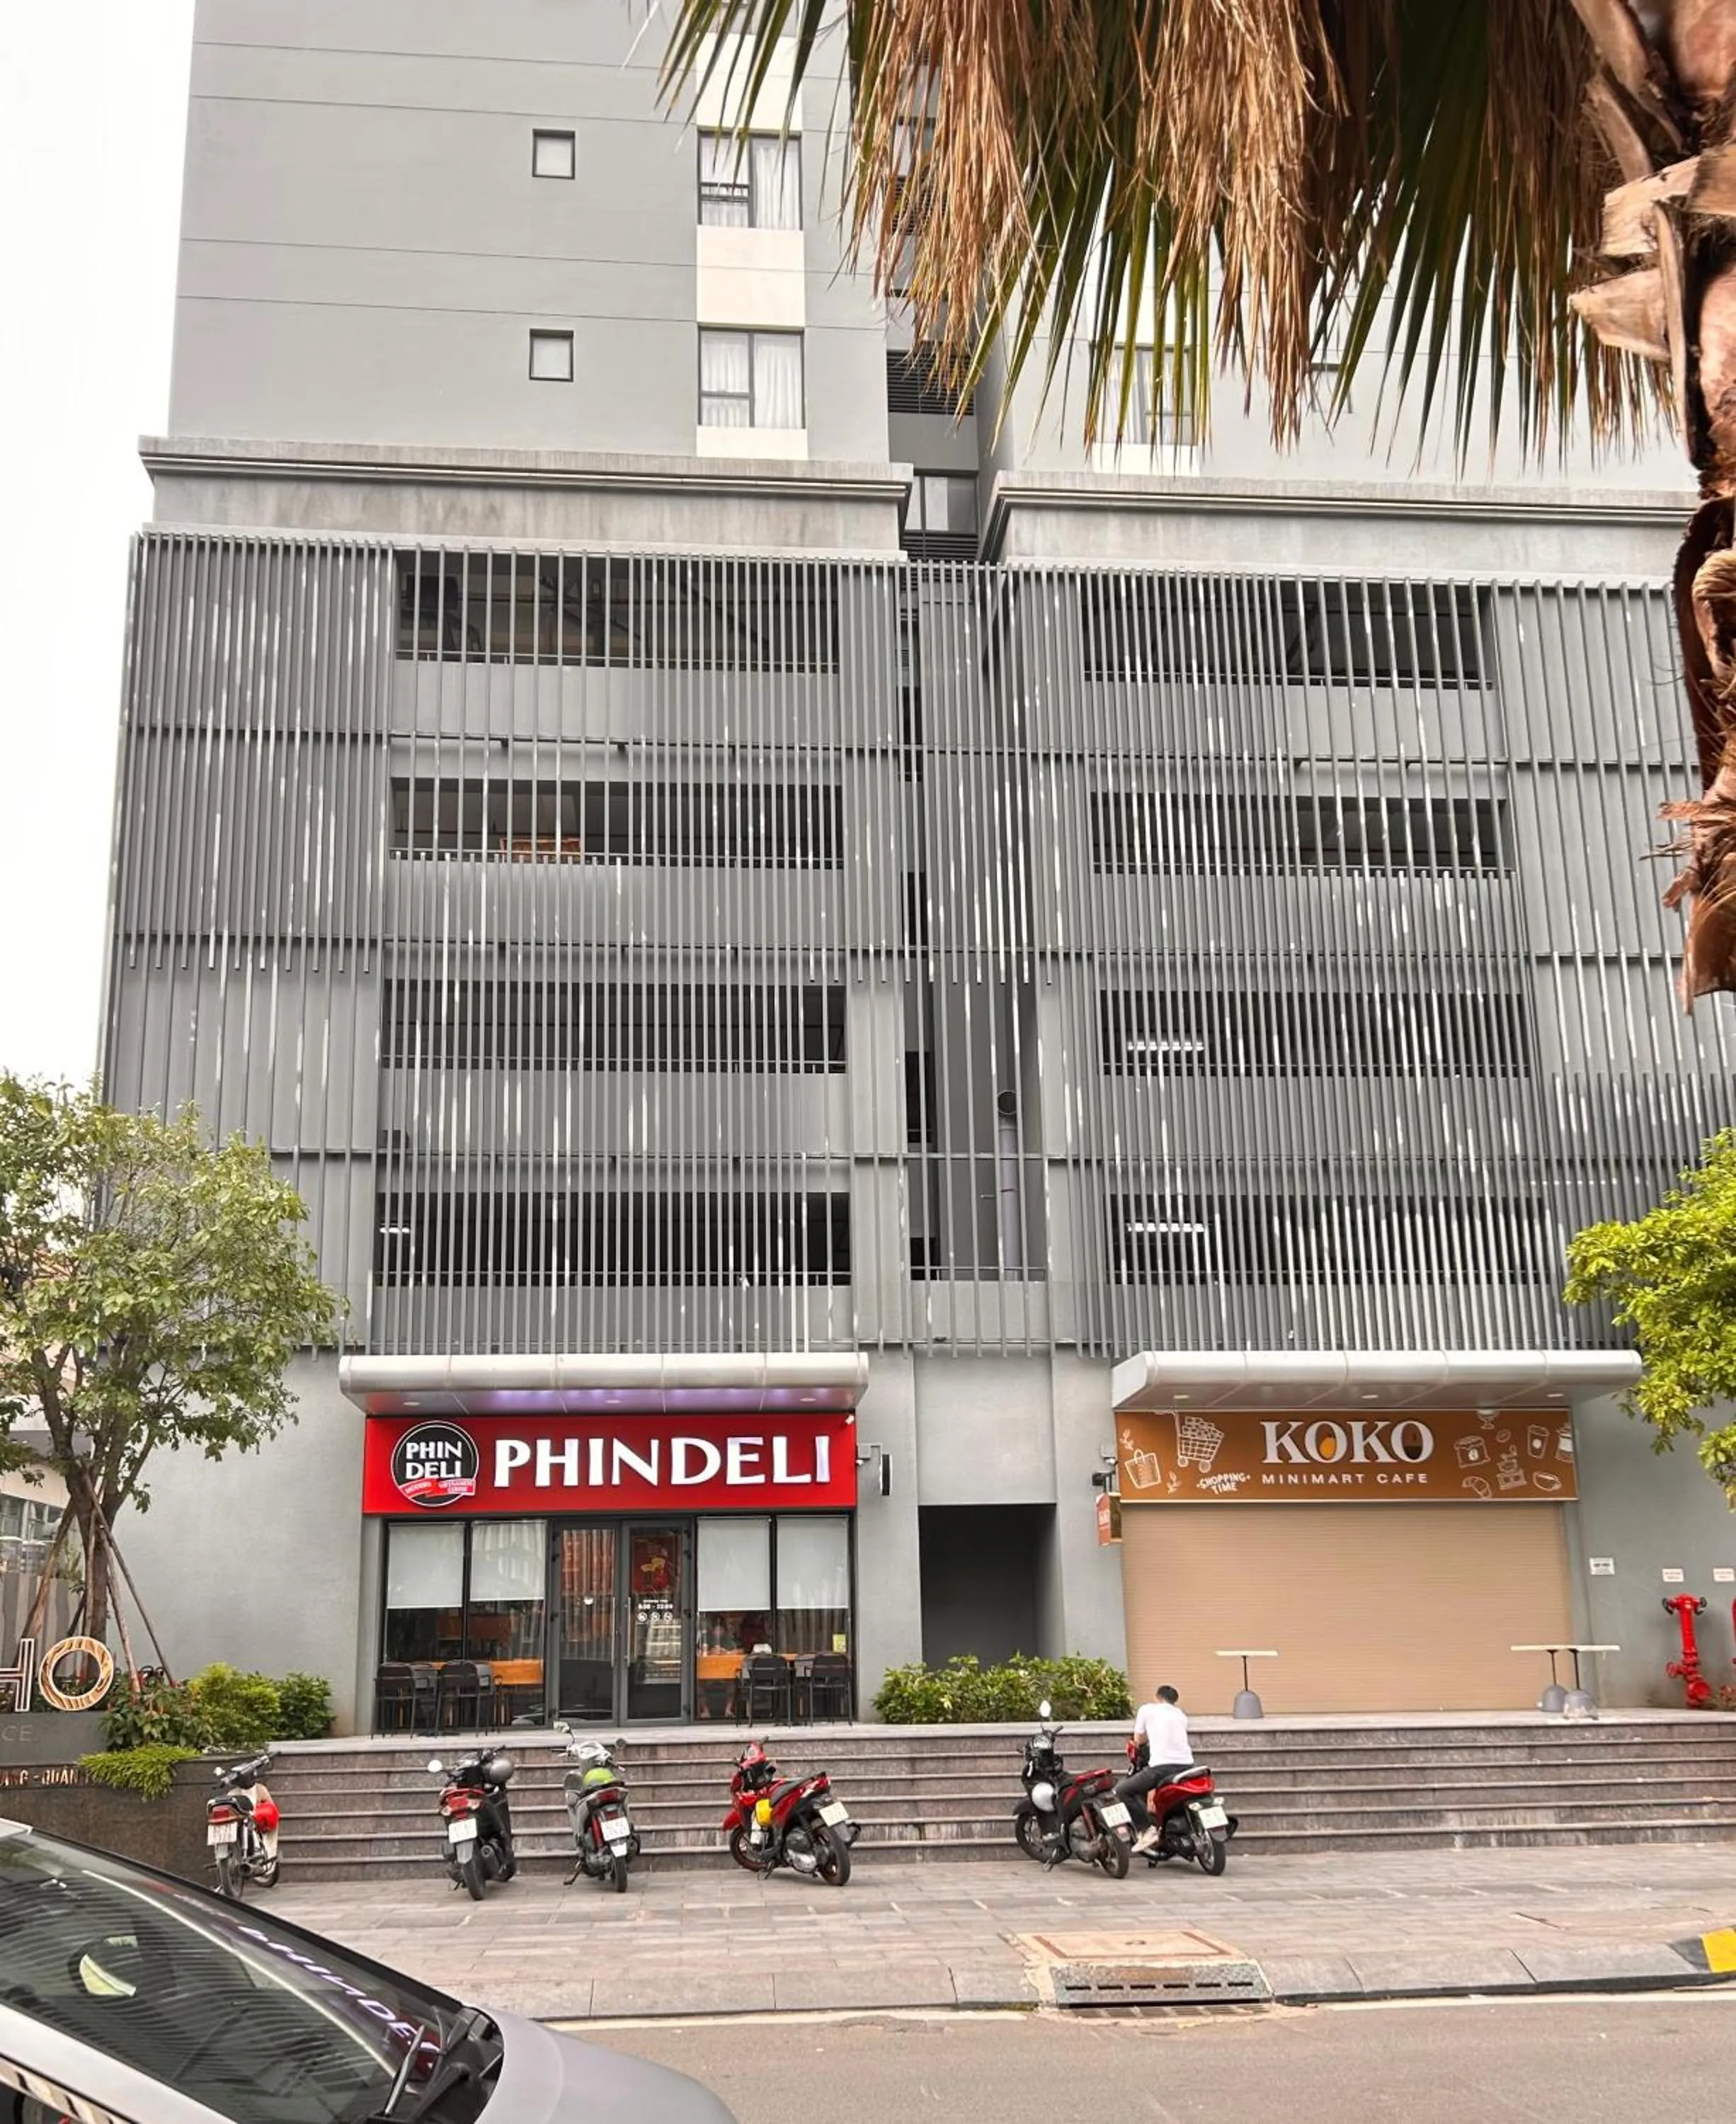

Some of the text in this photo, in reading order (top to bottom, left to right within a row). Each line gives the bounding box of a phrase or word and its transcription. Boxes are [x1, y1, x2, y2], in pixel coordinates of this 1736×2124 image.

[406, 1441, 462, 1459] PHIN
[1260, 1420, 1434, 1463] KOKO
[406, 1461, 462, 1479] DELI
[494, 1435, 830, 1487] PHINDELI
[1199, 1472, 1247, 1489] SHOPPING
[1262, 1473, 1428, 1485] MINIMART CAFE
[1211, 1482, 1238, 1495] TIME
